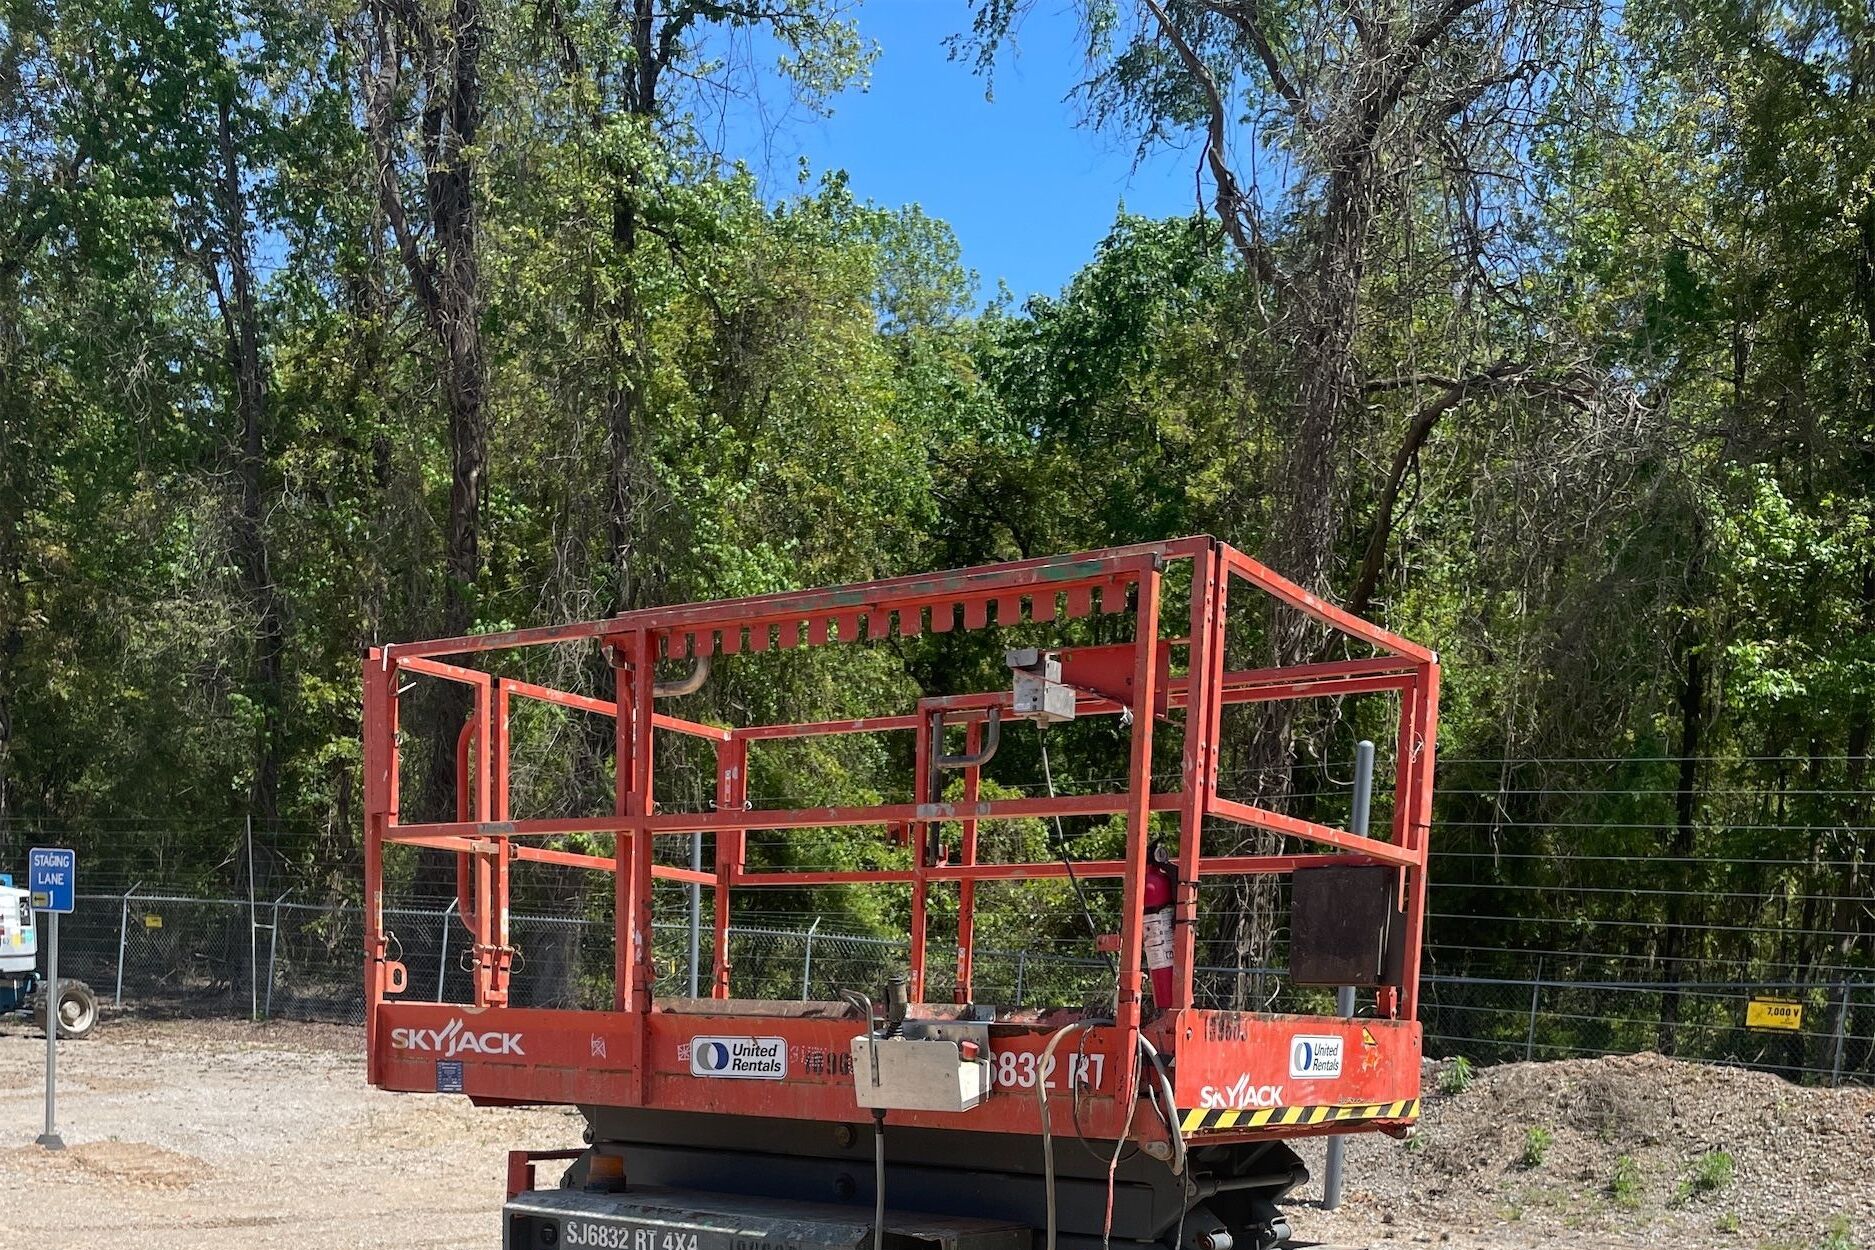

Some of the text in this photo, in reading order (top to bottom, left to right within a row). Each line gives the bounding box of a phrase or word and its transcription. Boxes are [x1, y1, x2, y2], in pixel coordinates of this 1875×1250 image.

[34, 854, 70, 868] STAGING
[38, 872, 65, 886] LANE
[1794, 1008, 1799, 1017] V
[391, 1017, 525, 1057] SKYJACK
[732, 1043, 778, 1057] United
[1314, 1042, 1339, 1057] United
[731, 1058, 782, 1072] Rentals
[1312, 1058, 1339, 1072] Rentals
[1200, 1072, 1283, 1110] SKYJACK
[566, 1221, 629, 1250] SJ6832
